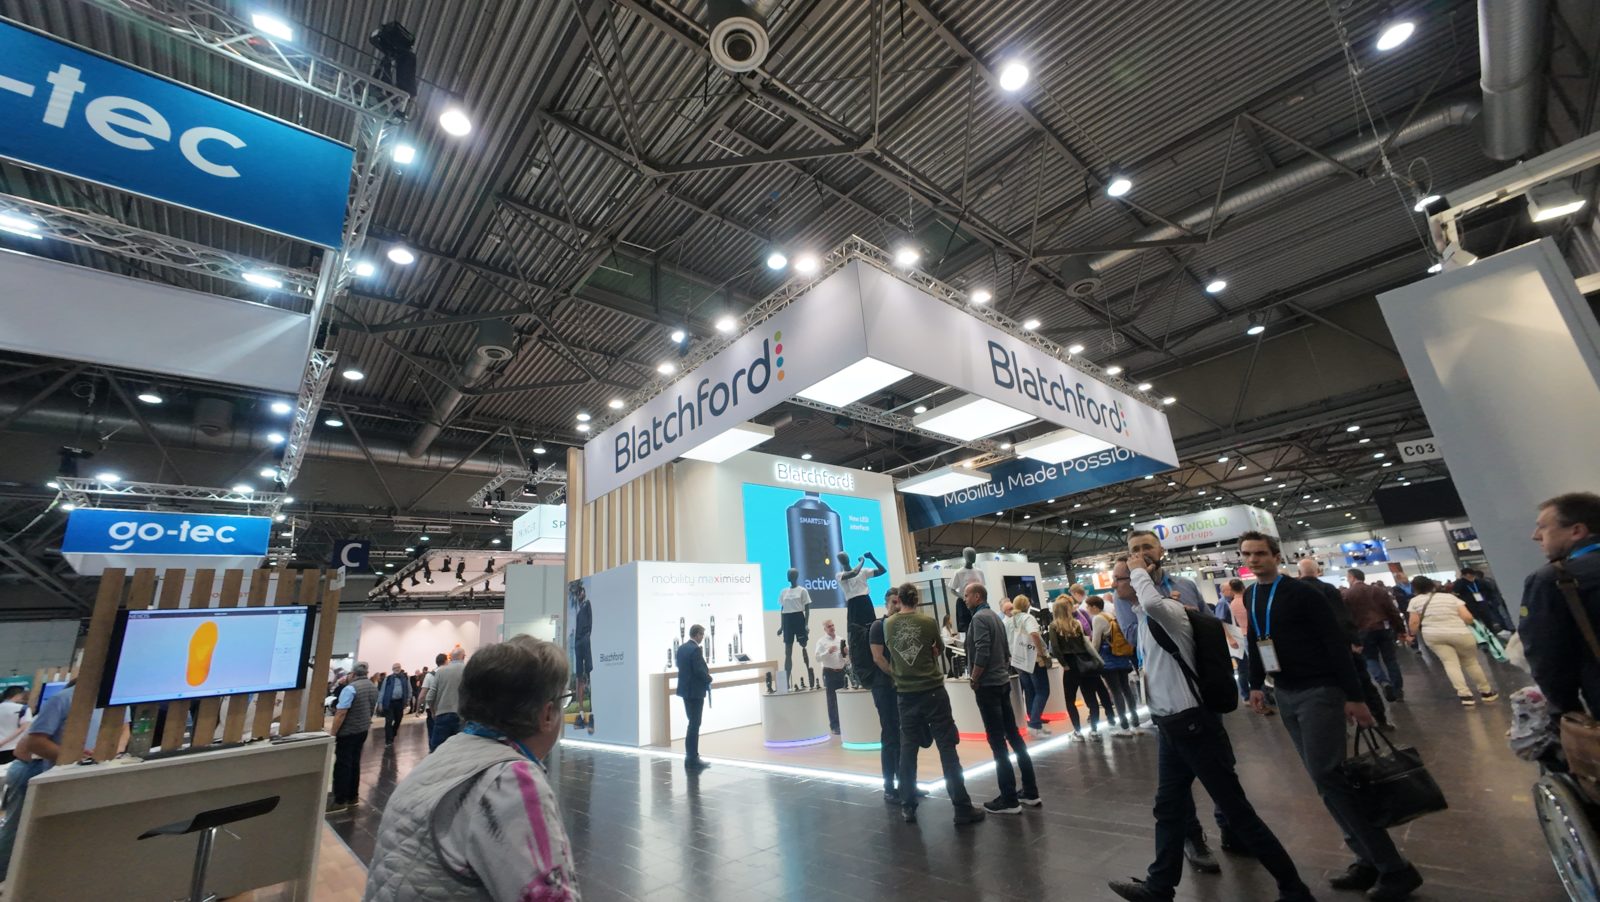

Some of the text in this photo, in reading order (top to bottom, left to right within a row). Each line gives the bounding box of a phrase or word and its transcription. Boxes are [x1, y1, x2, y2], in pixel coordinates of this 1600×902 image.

[988, 340, 1122, 433] Blatchford
[615, 338, 771, 473] Blatchford
[1404, 443, 1436, 456] C03
[777, 463, 850, 488] Blatchford
[943, 480, 1004, 507] Mobility
[1007, 465, 1057, 491] Made
[109, 520, 236, 550] go-tec
[1171, 518, 1228, 534] OTWORLD
[1174, 530, 1214, 543] start-ups
[340, 542, 362, 567] C
[651, 571, 751, 586] mobility maximised
[804, 576, 838, 590] active
